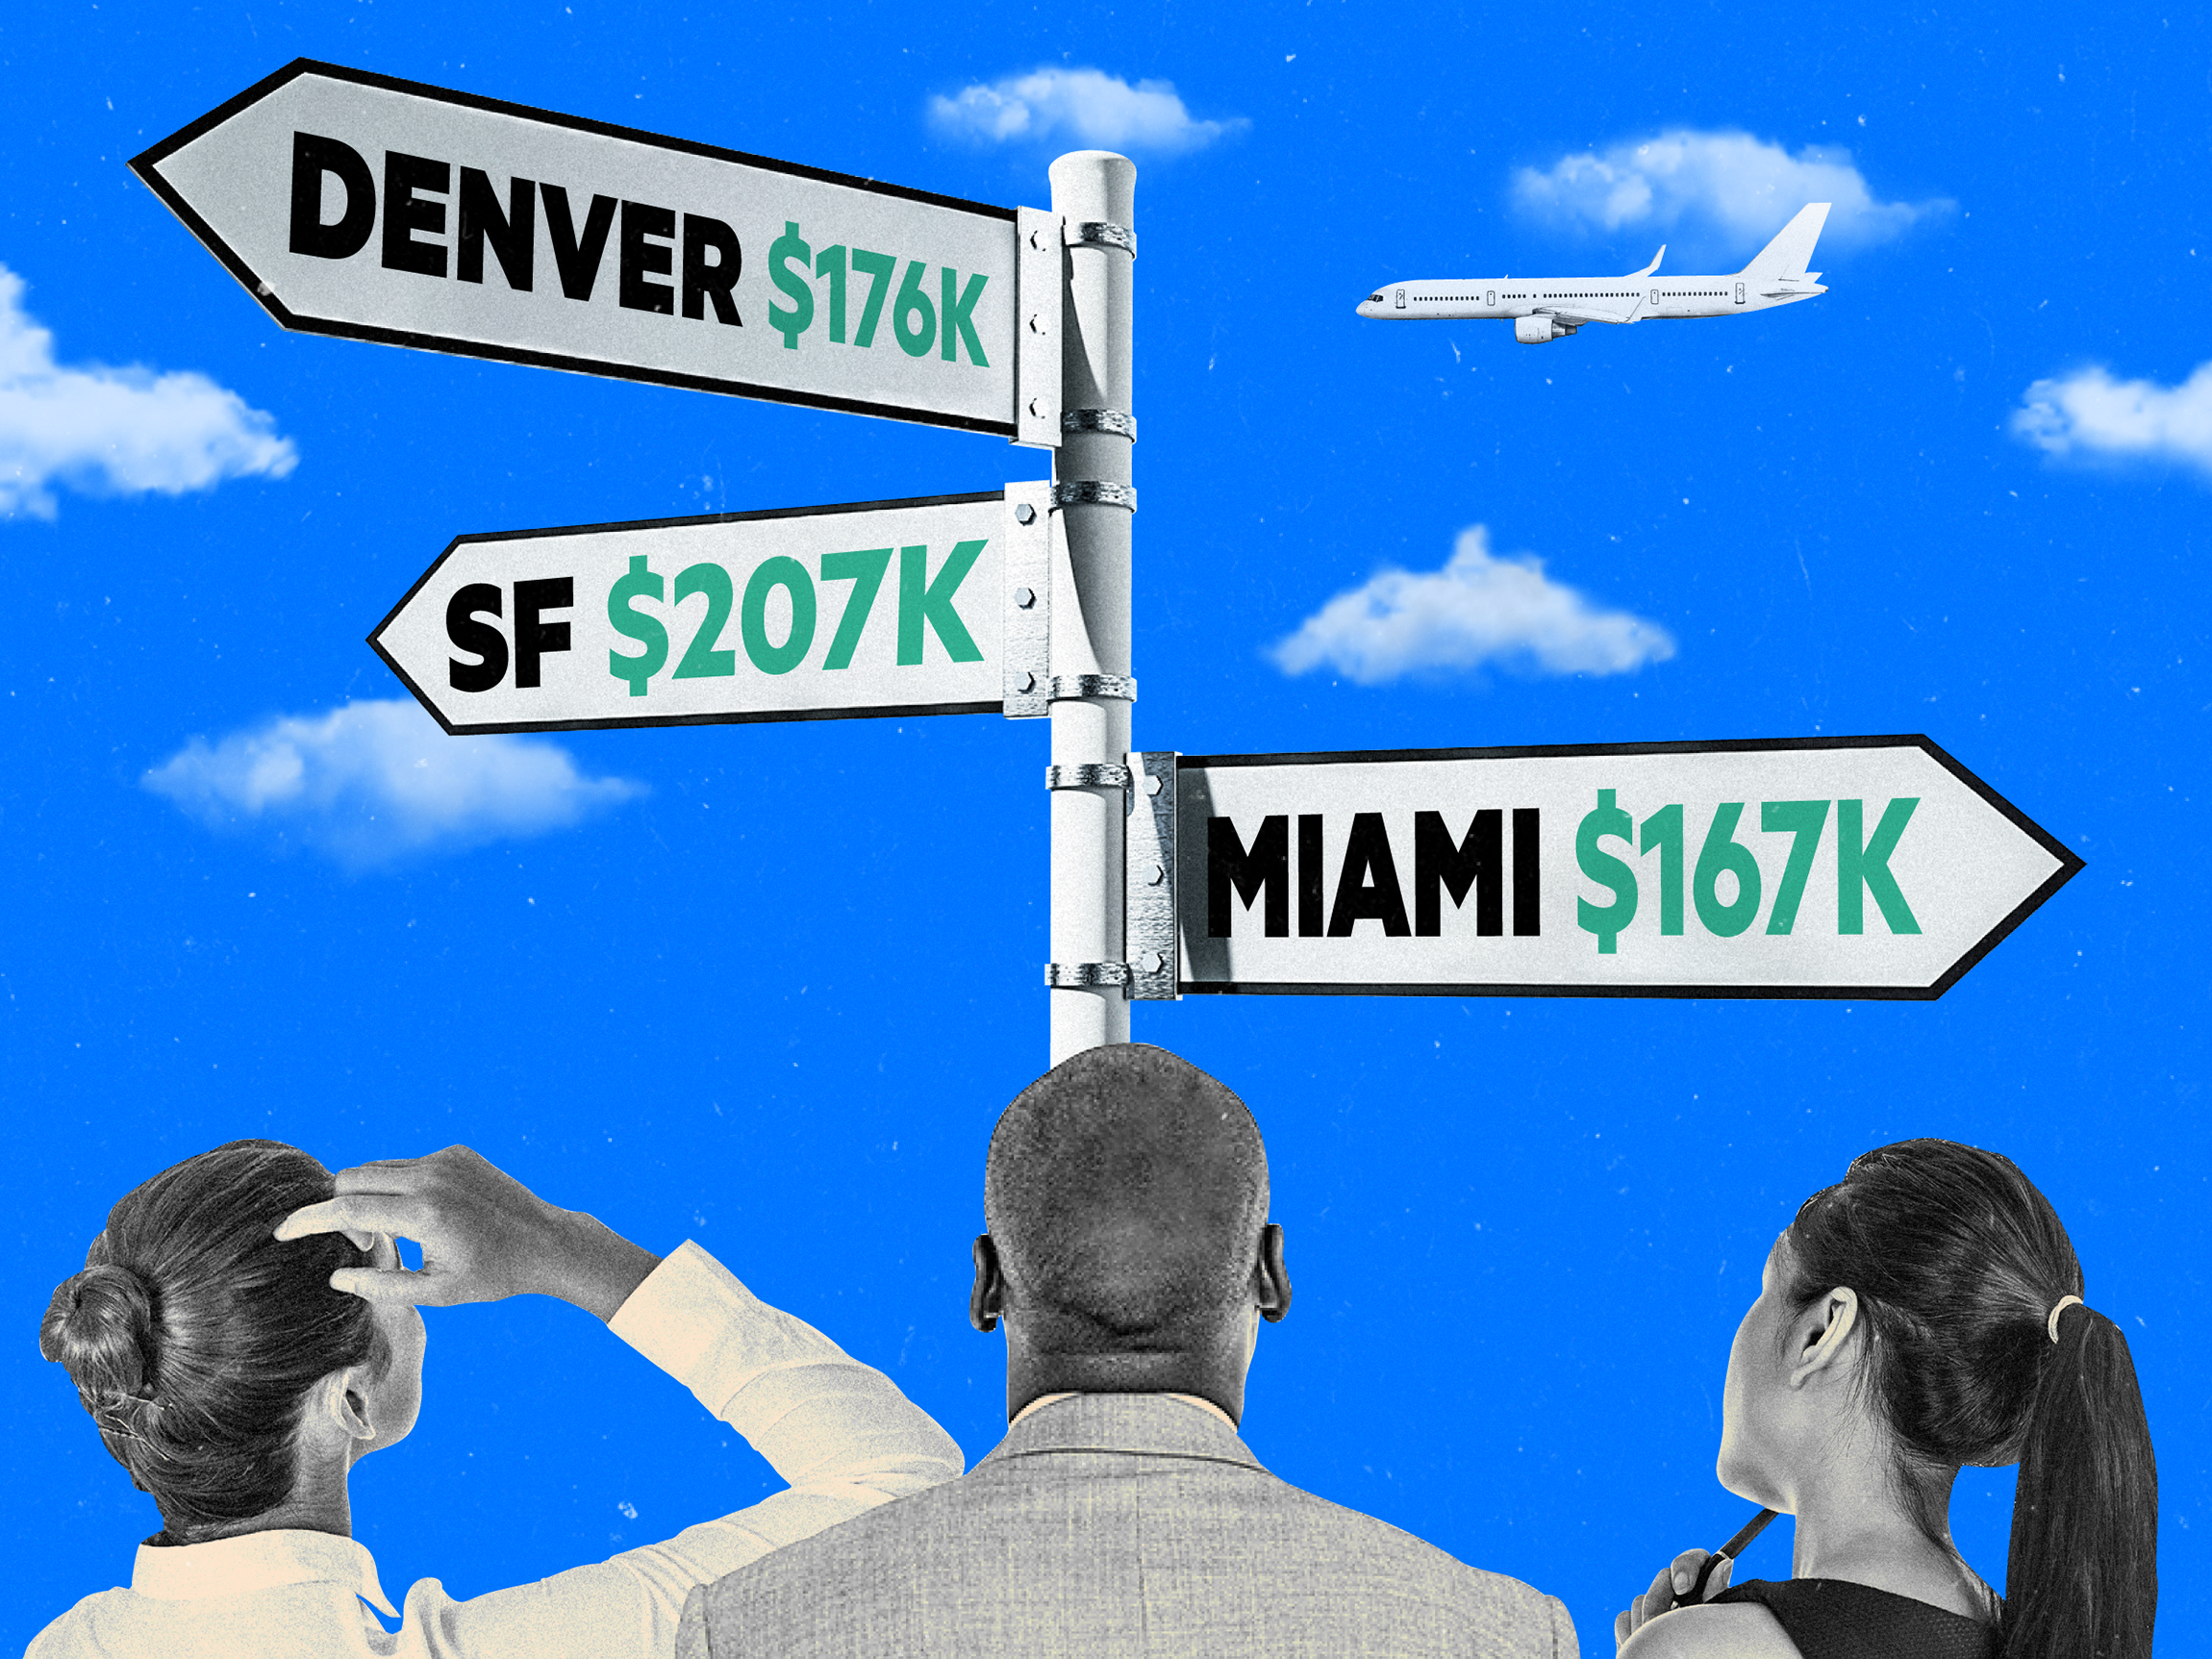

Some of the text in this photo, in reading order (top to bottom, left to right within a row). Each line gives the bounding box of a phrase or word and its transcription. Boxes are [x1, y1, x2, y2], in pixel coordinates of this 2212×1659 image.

[289, 131, 991, 368] DENVER $176K
[445, 540, 990, 697] SF $207K
[1207, 788, 1923, 955] MIAMI $167K
